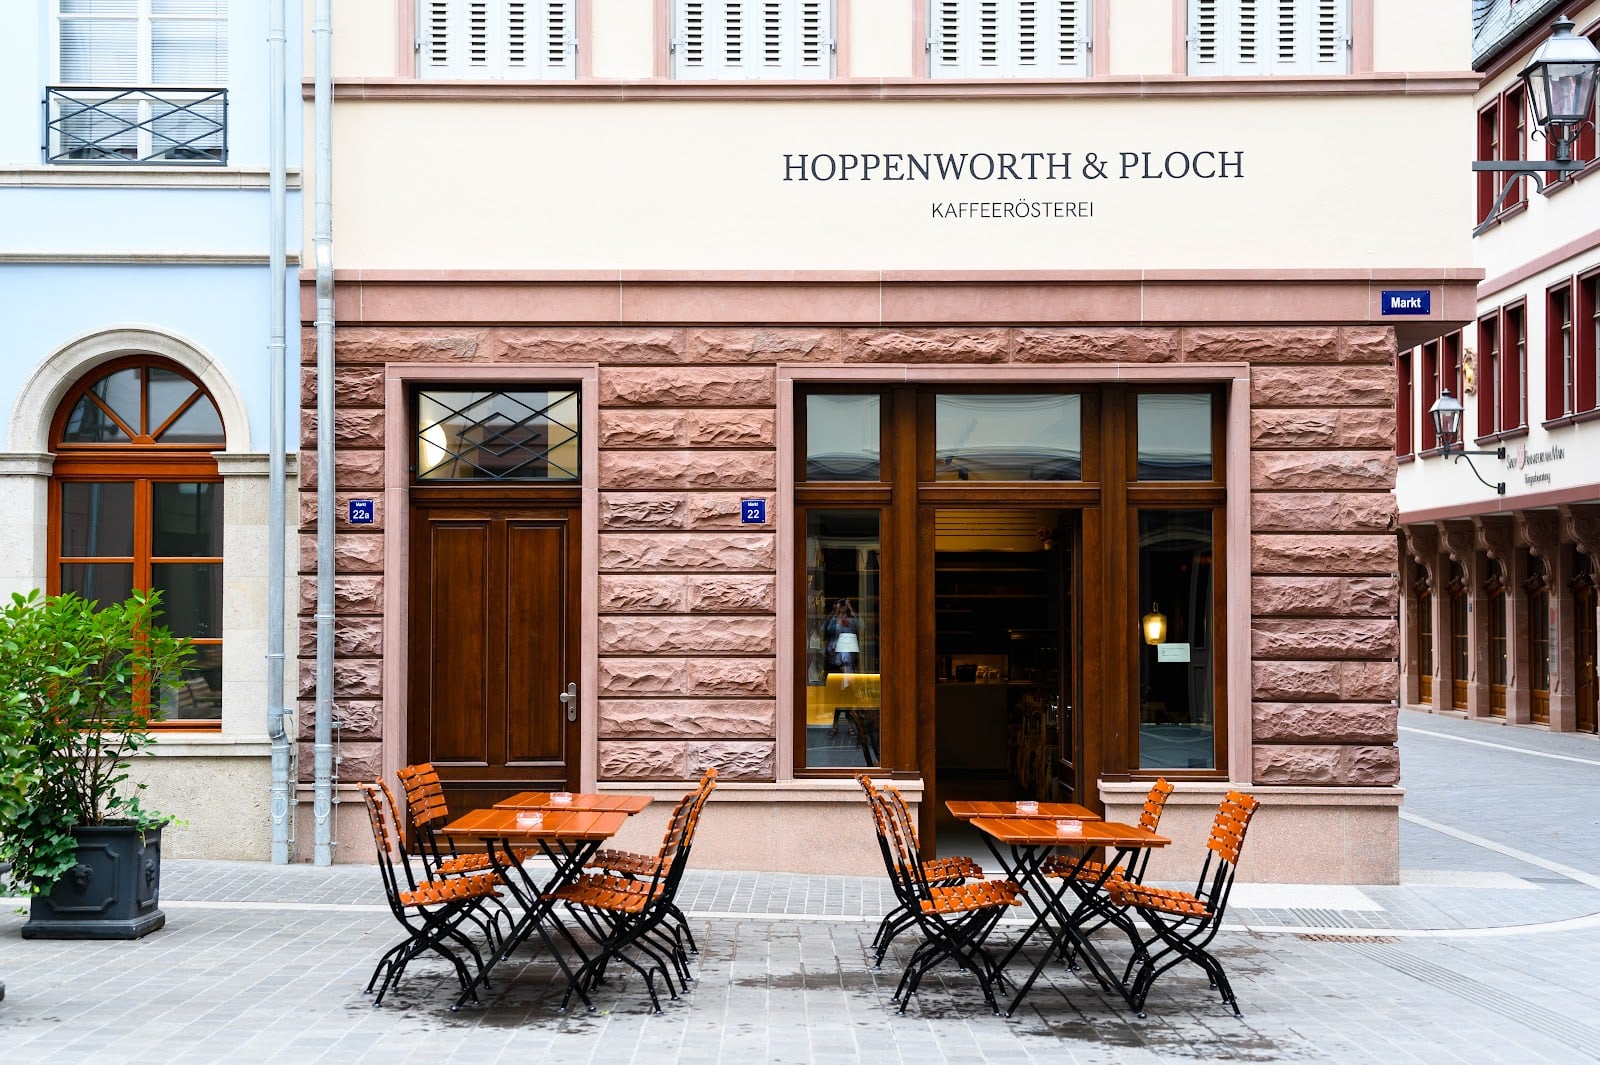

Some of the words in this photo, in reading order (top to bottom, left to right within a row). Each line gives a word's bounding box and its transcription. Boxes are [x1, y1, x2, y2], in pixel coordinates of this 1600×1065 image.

[782, 152, 1072, 181] HOPPENWORTH
[1082, 152, 1108, 179] &
[1118, 151, 1245, 179] PLOCH
[932, 198, 1093, 218] KAFFEERÖSTEREI
[1391, 296, 1421, 308] Markt
[352, 509, 370, 520] 22a
[747, 509, 760, 519] 22
